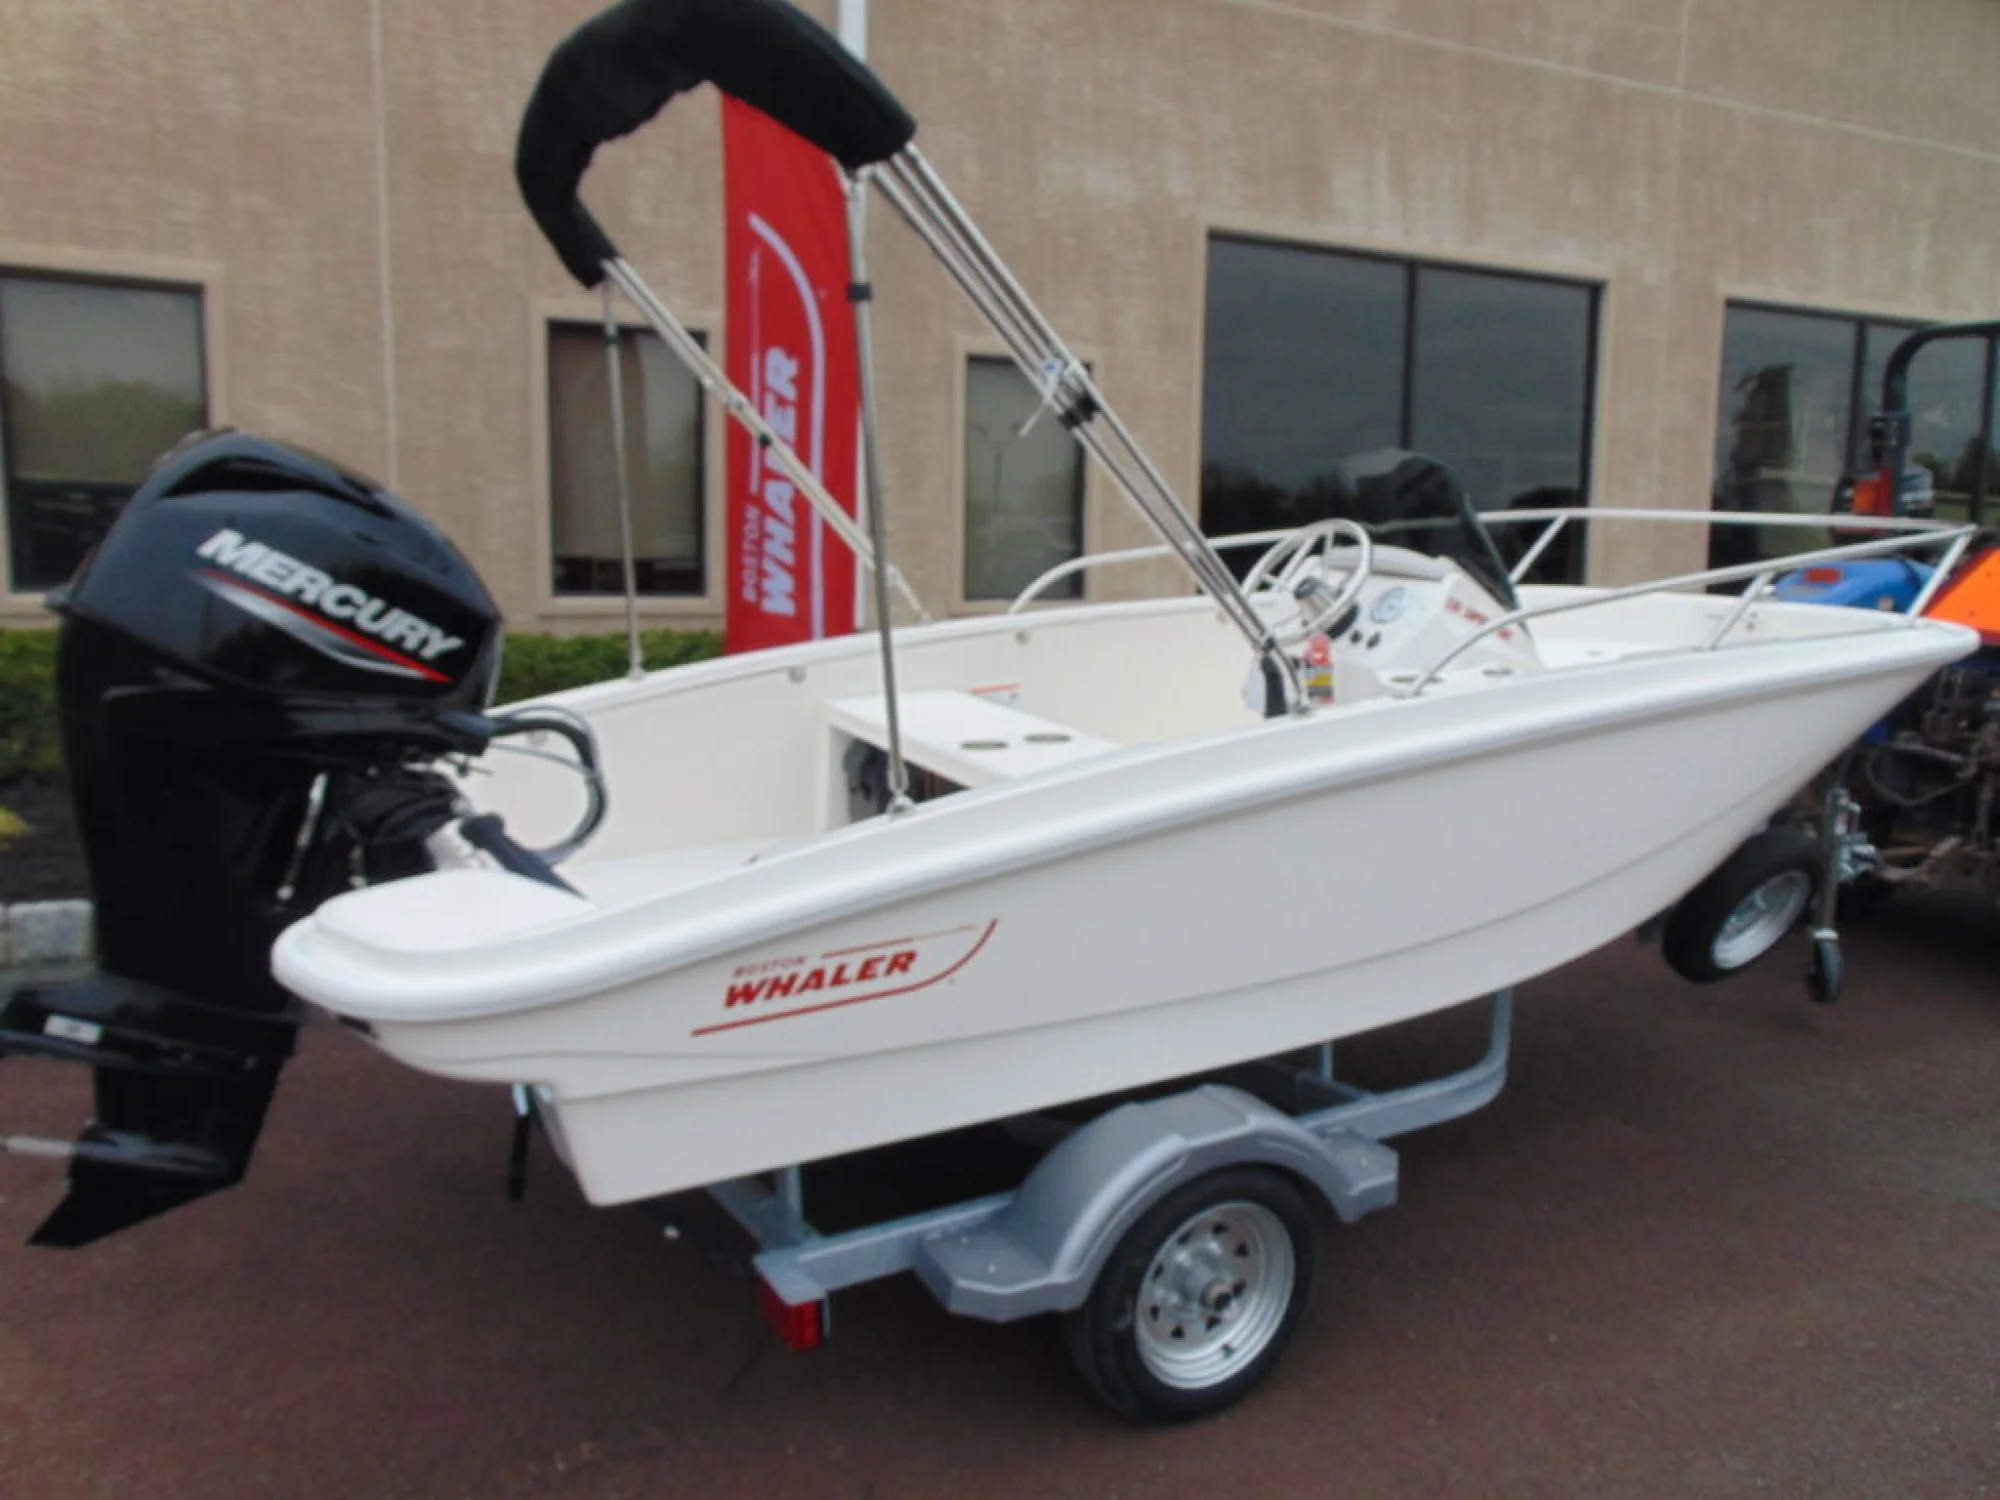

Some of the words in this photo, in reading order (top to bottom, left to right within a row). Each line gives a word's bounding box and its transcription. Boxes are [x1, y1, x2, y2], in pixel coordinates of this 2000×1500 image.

[742, 502, 761, 602] BOSTON
[196, 528, 464, 659] MERCURY
[724, 950, 917, 1010] WHALER
[733, 954, 806, 977] BOSTON
